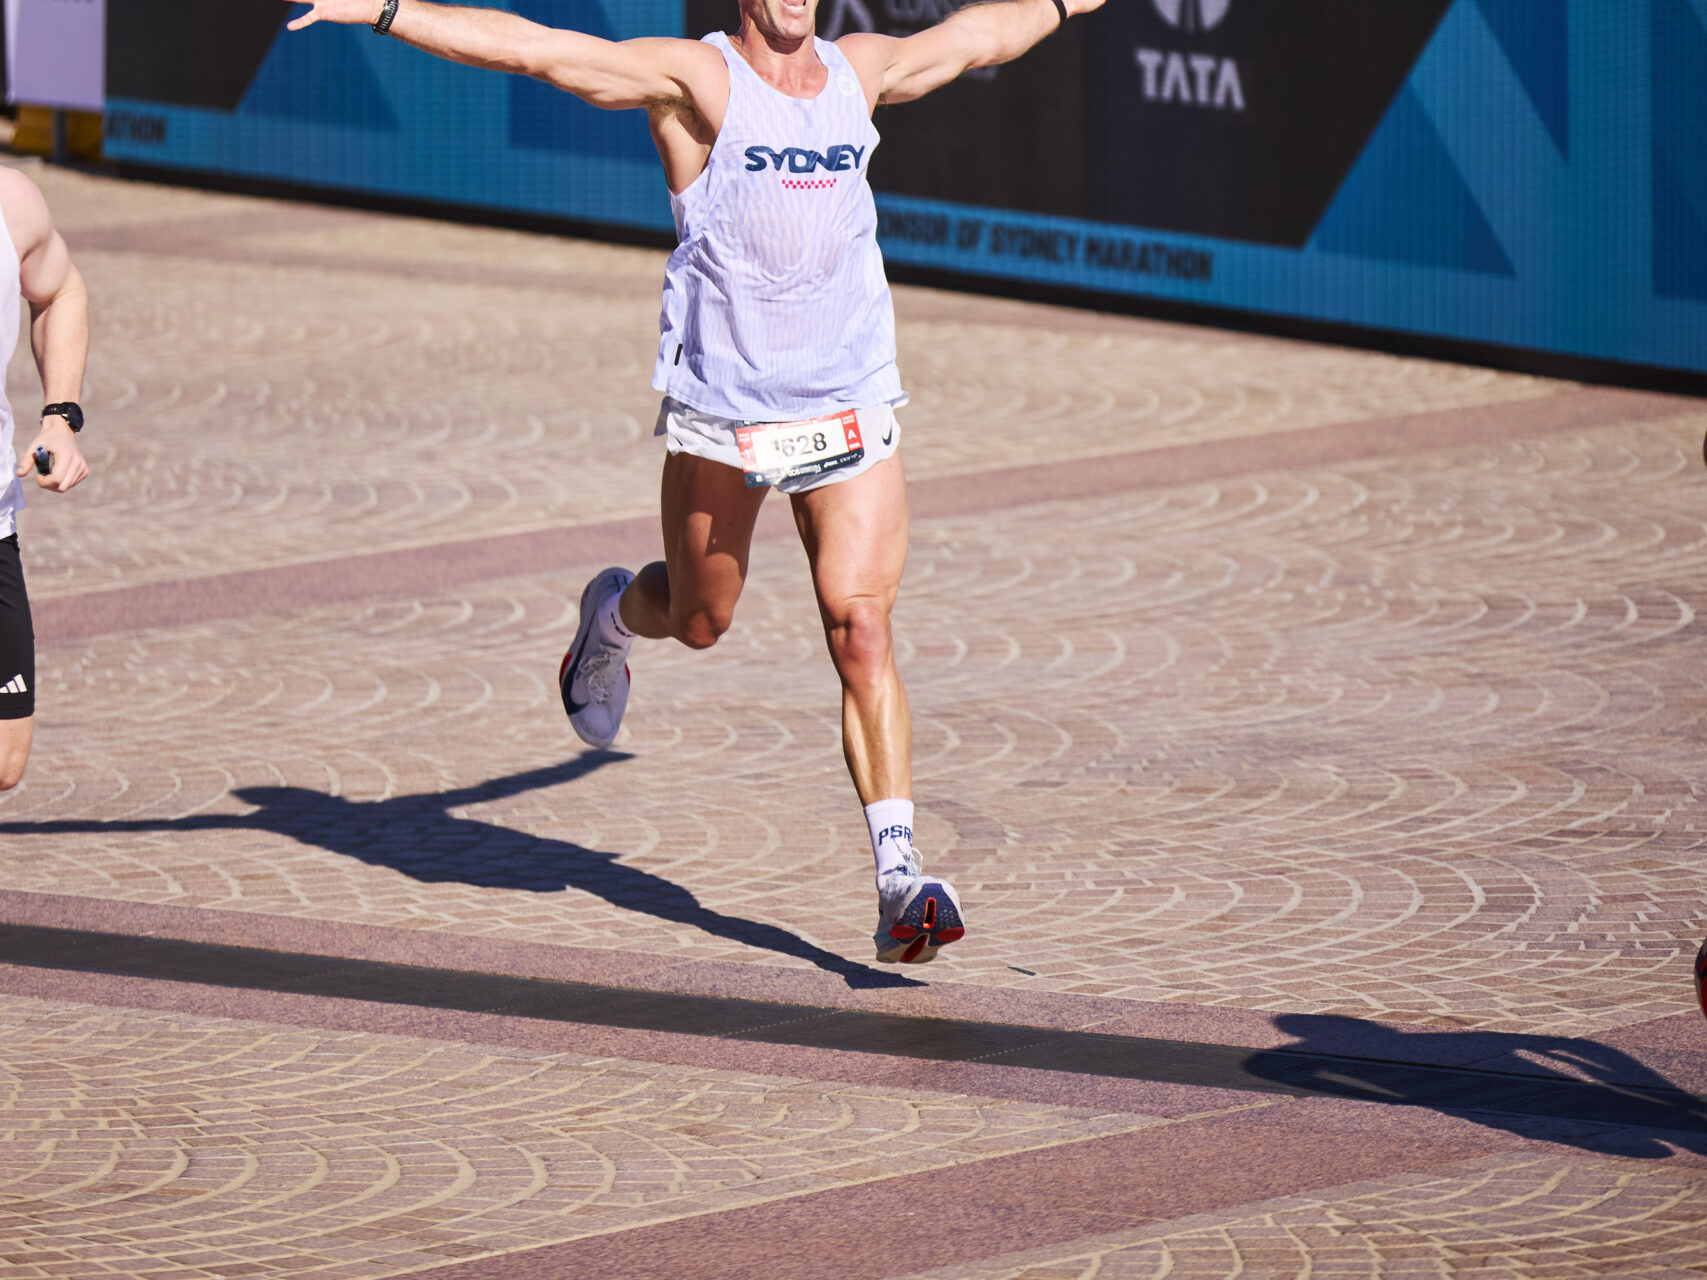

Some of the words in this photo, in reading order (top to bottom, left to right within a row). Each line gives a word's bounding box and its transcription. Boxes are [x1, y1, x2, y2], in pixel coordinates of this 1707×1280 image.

[1135, 47, 1245, 111] TATA
[744, 144, 865, 173] SYDNEY
[956, 218, 982, 250] OF
[991, 222, 1079, 264] SYDNEY
[1086, 235, 1214, 283] MARATHON
[847, 428, 857, 440] A
